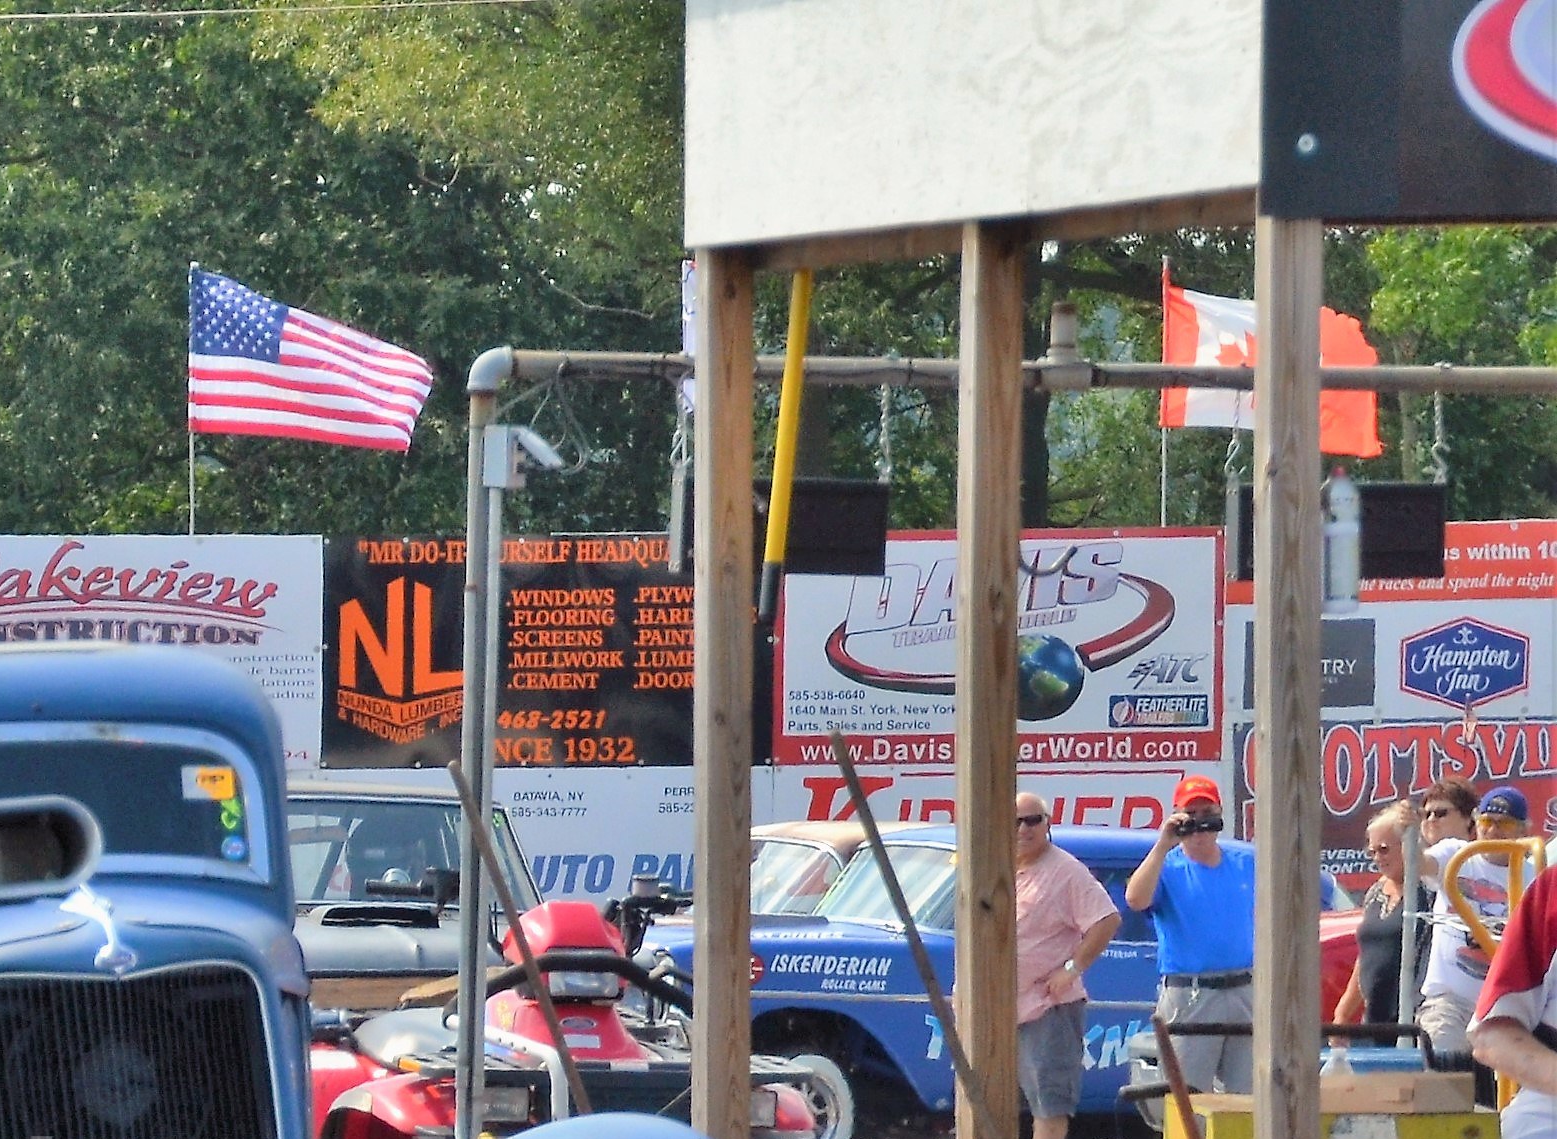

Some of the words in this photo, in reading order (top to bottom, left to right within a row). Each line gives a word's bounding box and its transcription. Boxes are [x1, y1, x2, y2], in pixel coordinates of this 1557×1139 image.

[1467, 542, 1530, 560] within
[1380, 578, 1414, 591] races
[1418, 577, 1445, 590] and
[1448, 573, 1488, 592] spend
[1491, 572, 1514, 587] the
[1517, 572, 1555, 591] night
[1411, 643, 1520, 675] Hampton
[1436, 669, 1490, 694] Inn
[789, 705, 816, 716] 1640
[819, 704, 847, 716] Main
[903, 704, 930, 715] New
[1136, 697, 1207, 713] FEATHERLITE
[788, 720, 823, 733] Parts,
[826, 720, 857, 731] Sales
[861, 719, 883, 731] and
[886, 719, 932, 731] Service
[563, 735, 636, 764] 1932
[567, 791, 585, 801] NY
[770, 954, 892, 976] ISKENDERIAN
[820, 978, 857, 991] ROLLER
[858, 979, 887, 992] CAMS
